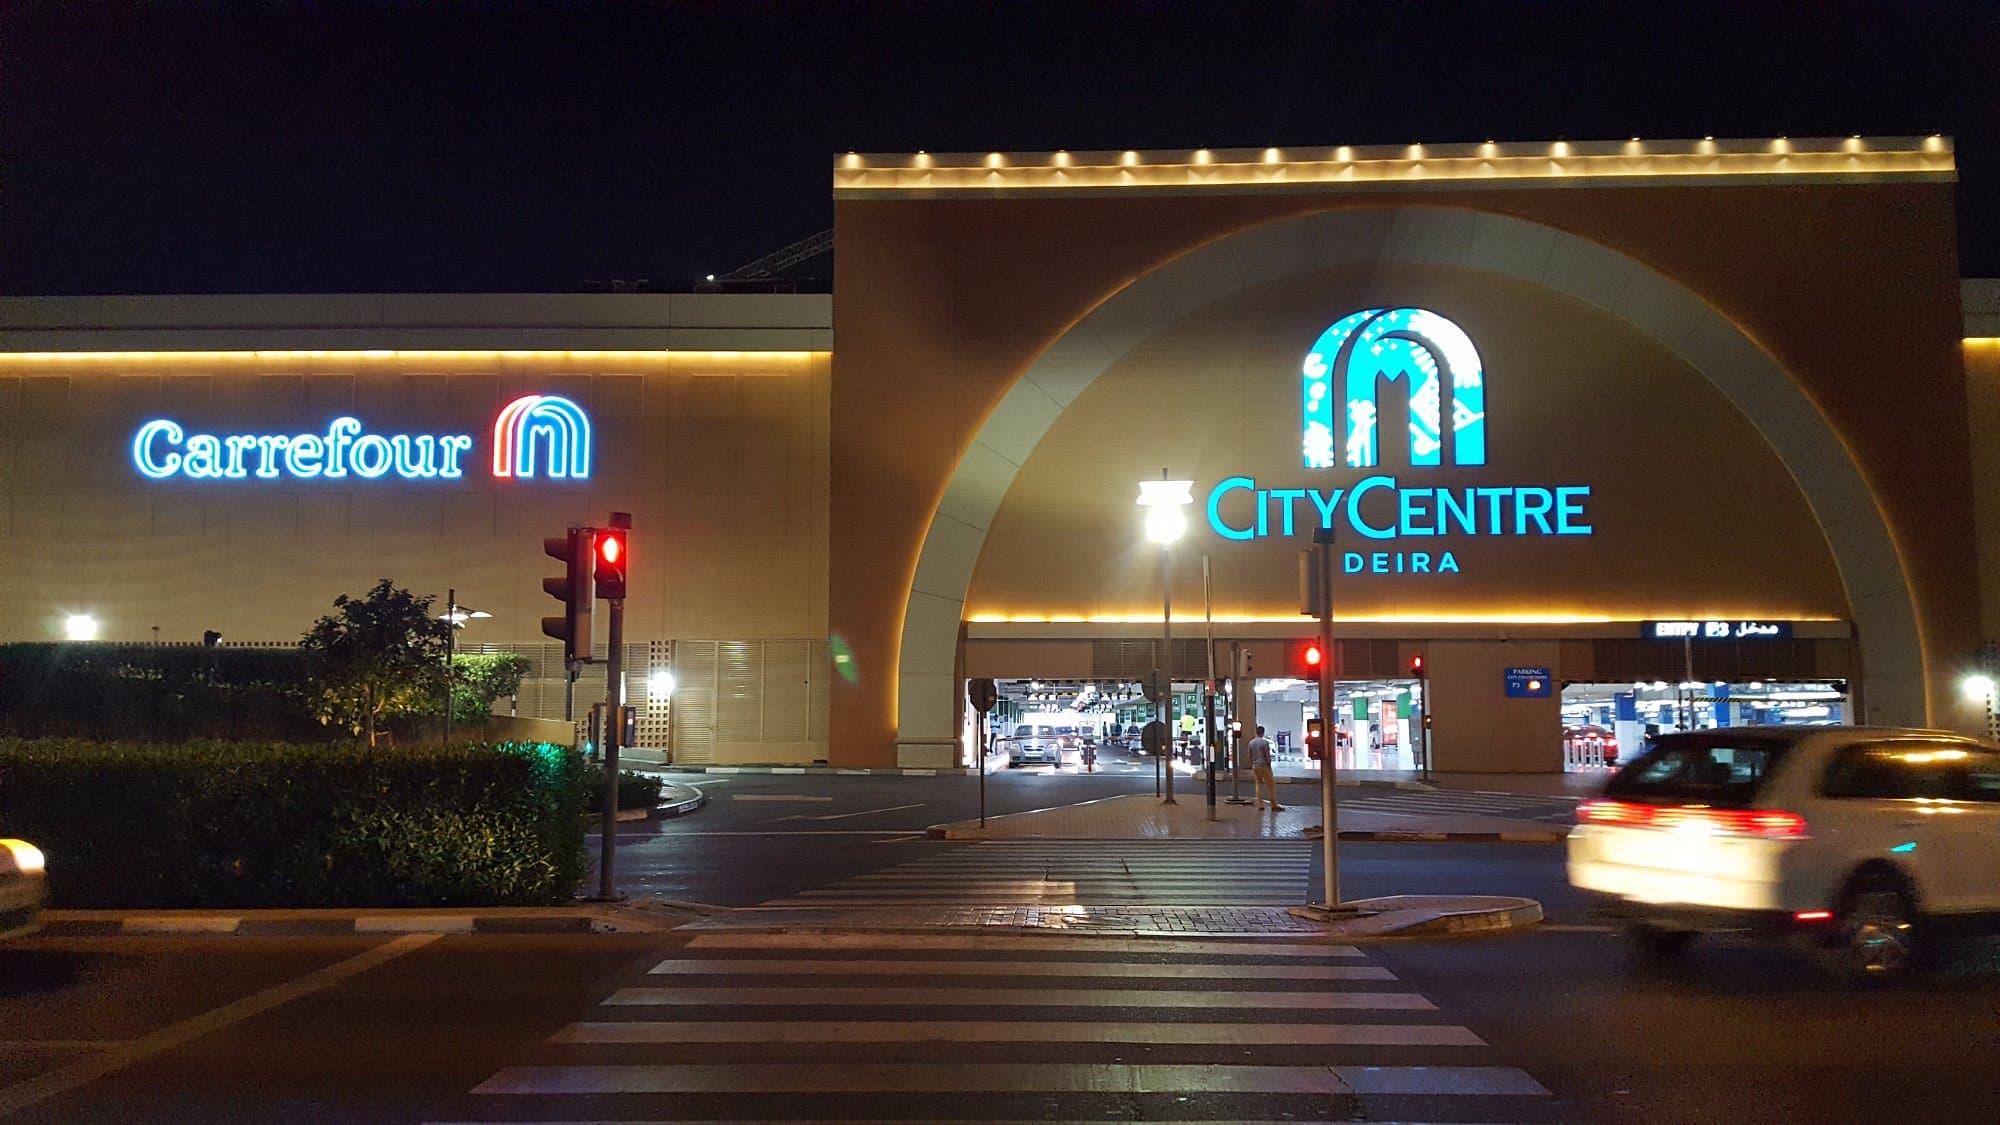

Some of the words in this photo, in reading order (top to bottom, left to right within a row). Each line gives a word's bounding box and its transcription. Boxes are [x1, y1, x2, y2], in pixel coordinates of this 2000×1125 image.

[134, 416, 472, 478] Carrefour
[1344, 551, 1461, 574] DEIRA
[1656, 622, 1699, 637] ENTRY
[1735, 622, 1779, 637] مدخل
